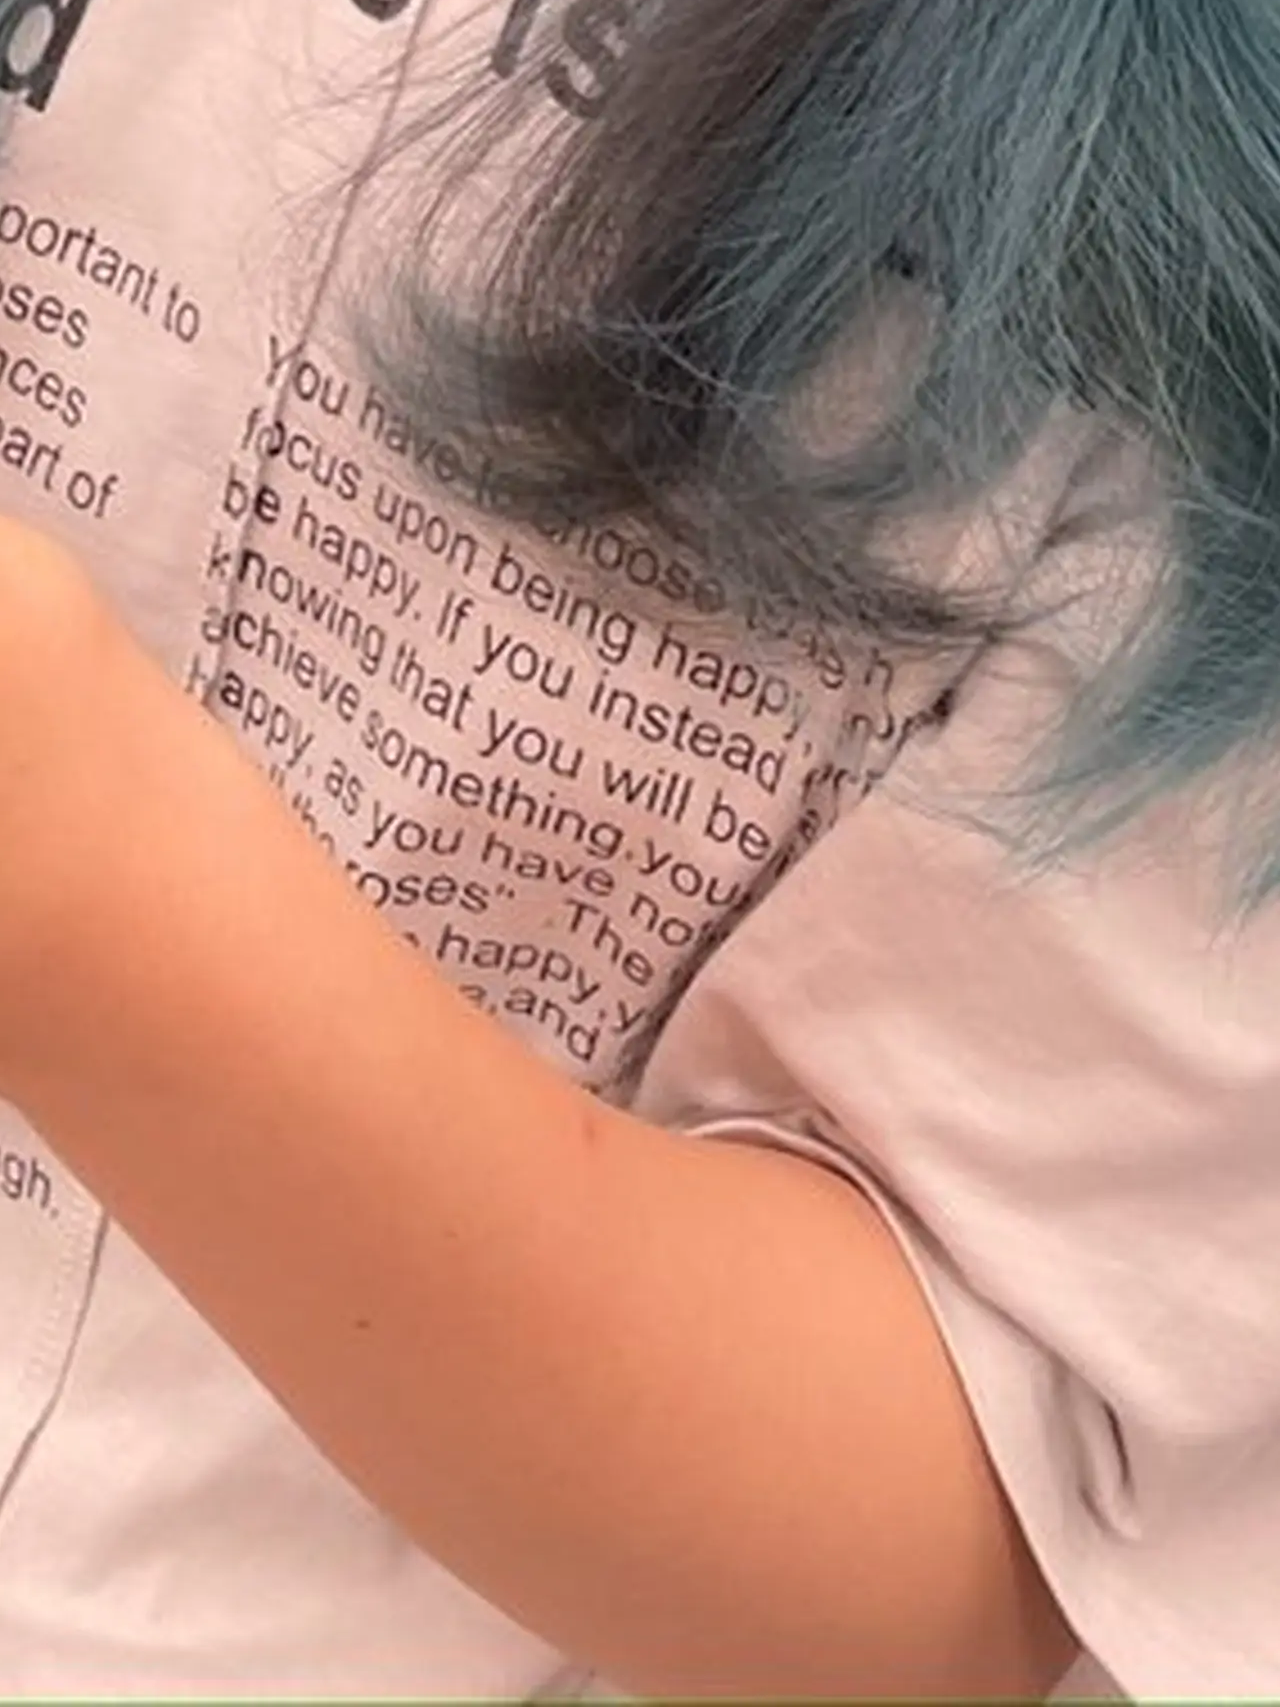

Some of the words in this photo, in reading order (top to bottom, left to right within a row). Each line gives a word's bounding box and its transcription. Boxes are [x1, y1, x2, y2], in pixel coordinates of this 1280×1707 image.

[162, 284, 202, 344] to
[265, 335, 351, 419] You
[65, 473, 118, 520] of
[241, 407, 363, 502] focus
[372, 490, 480, 577] upon
[489, 542, 638, 666] being
[200, 604, 362, 724] achieve
[221, 465, 282, 525] be
[434, 590, 475, 645] If
[473, 623, 576, 700] you
[587, 668, 788, 795] instead
[204, 532, 388, 677] knowing
[388, 638, 475, 733] that
[478, 708, 585, 780] you
[603, 754, 695, 825] will
[704, 789, 771, 863] be
[323, 755, 361, 818] as
[362, 798, 465, 857] you
[480, 836, 616, 903] have
[561, 895, 655, 988] The
[504, 985, 603, 1065] and
